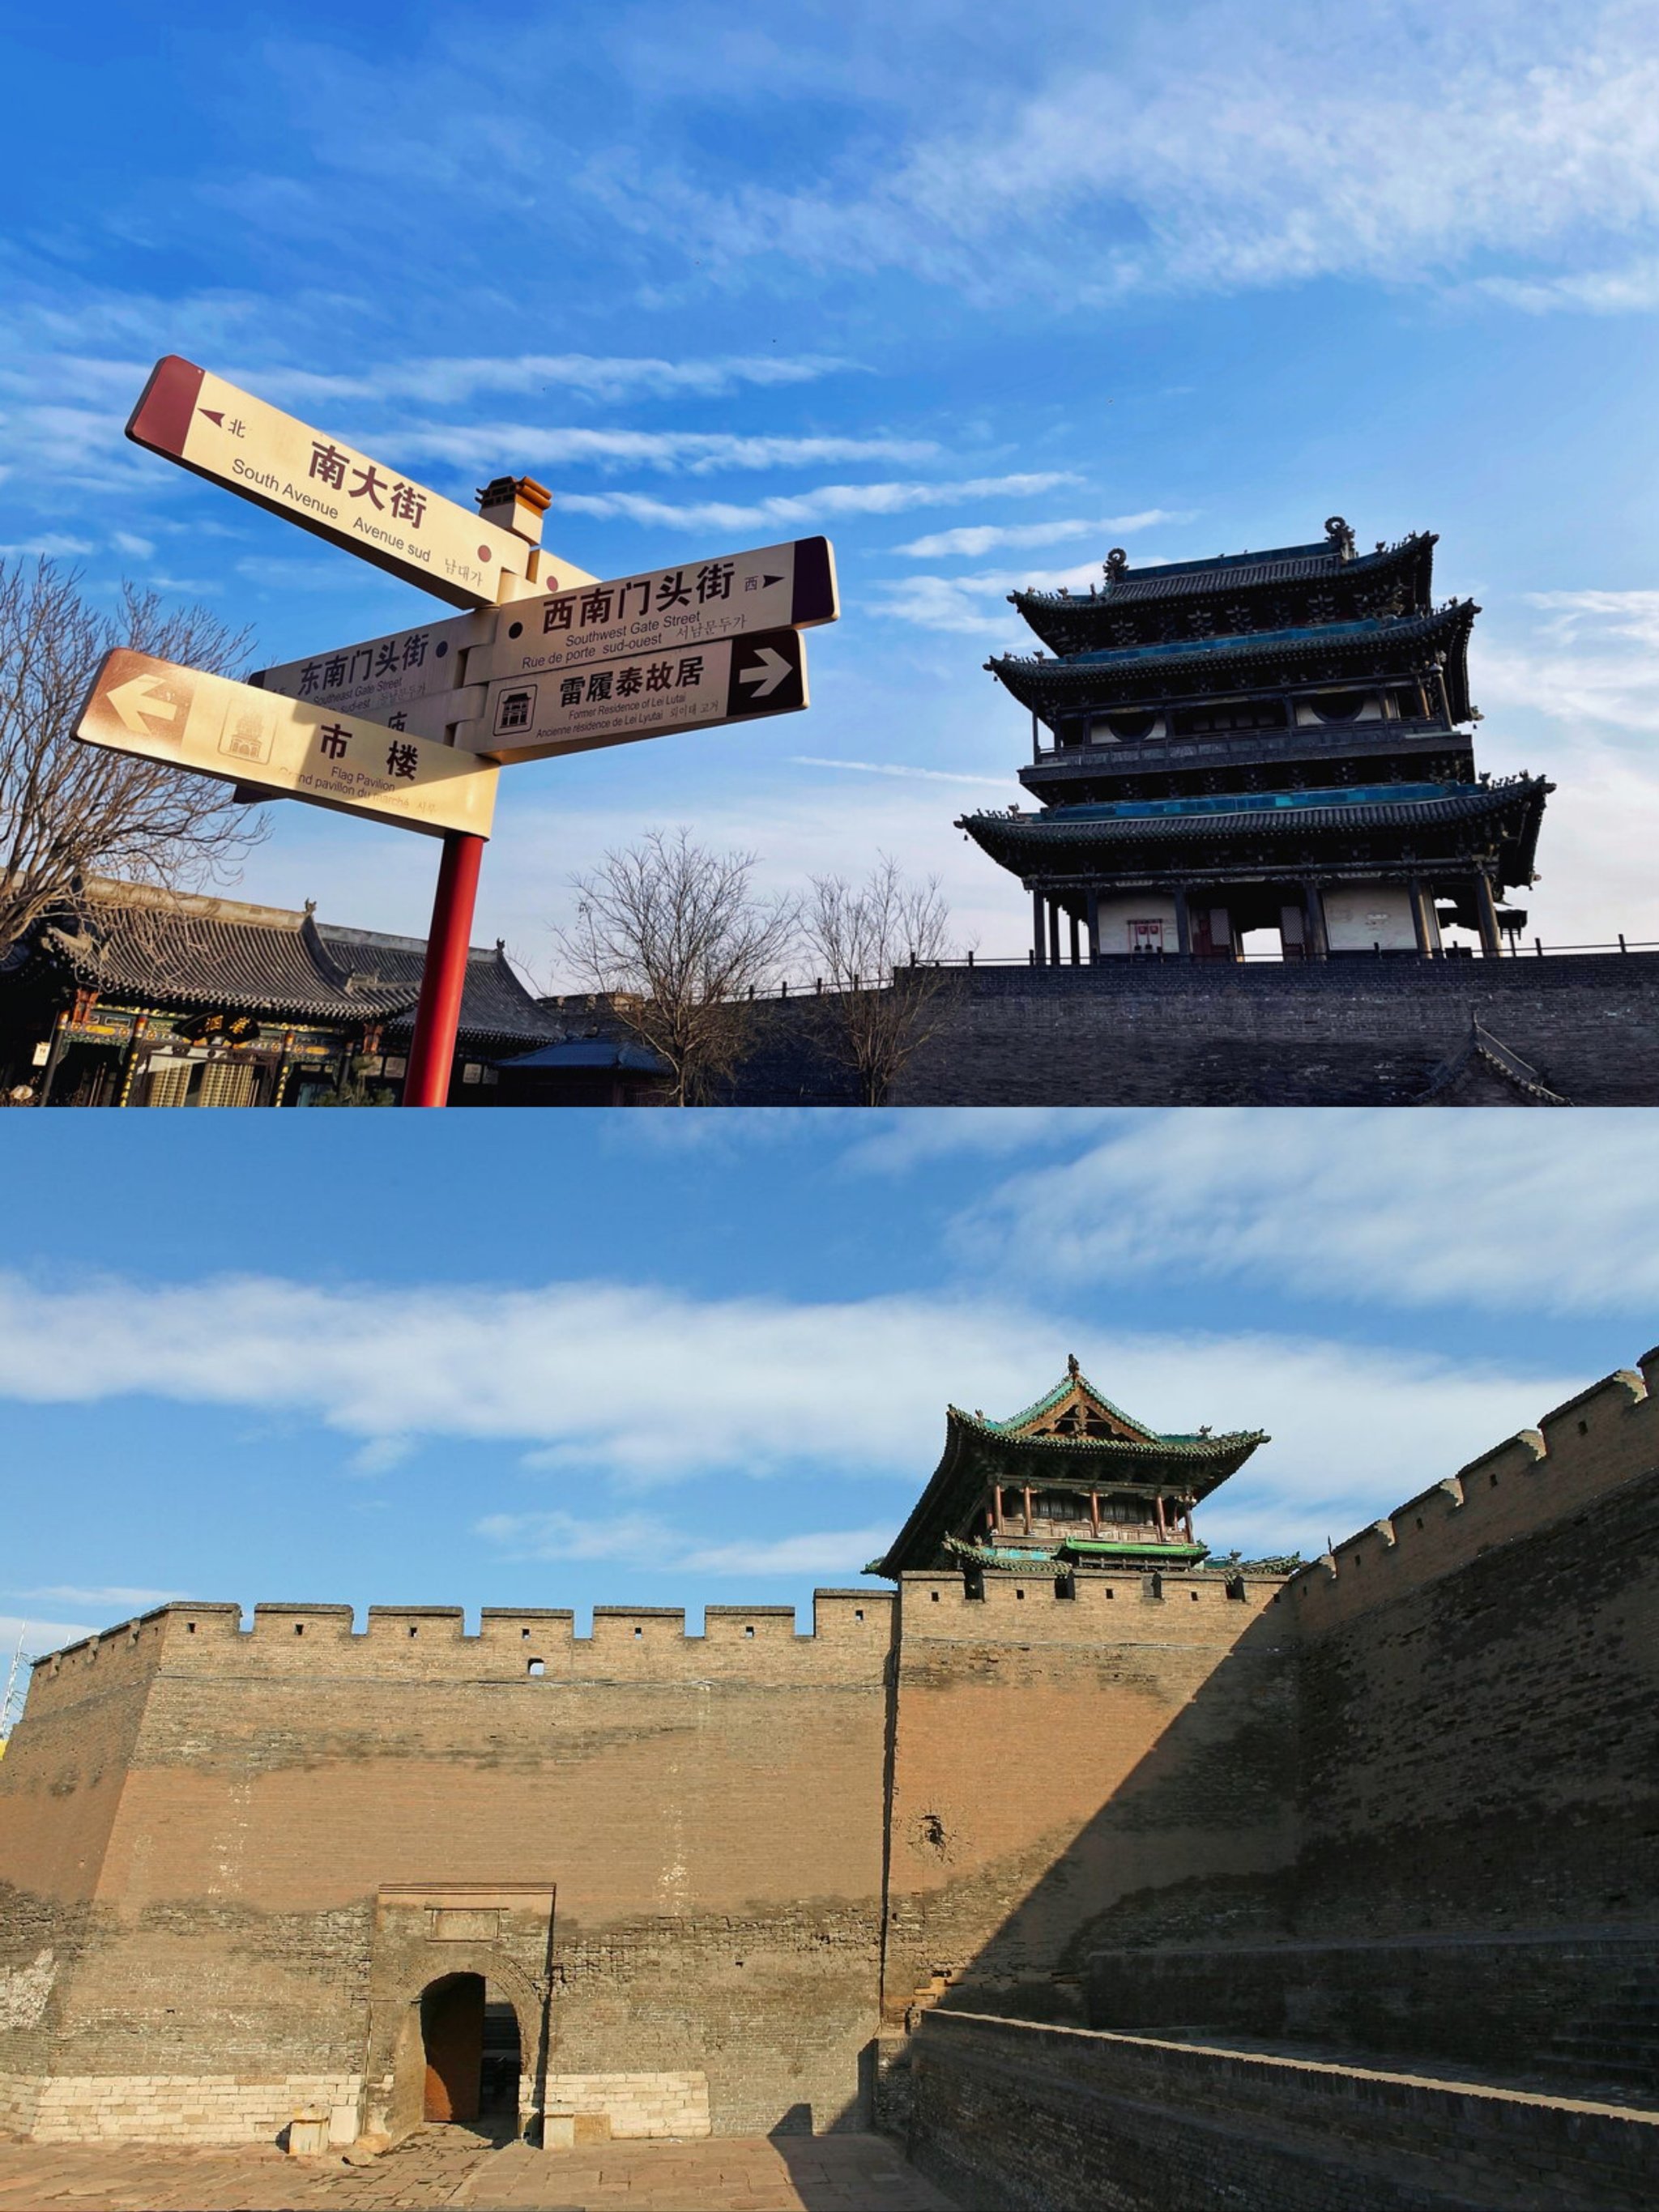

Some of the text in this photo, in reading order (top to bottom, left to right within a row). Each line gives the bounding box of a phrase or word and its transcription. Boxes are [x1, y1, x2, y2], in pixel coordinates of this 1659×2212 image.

[228, 419, 246, 438] 北
[309, 441, 427, 530] 南大街
[232, 458, 431, 562] South Avenue Avenue sud
[445, 557, 484, 587] 남대가
[744, 575, 759, 592] 西
[543, 562, 735, 634] 西南门头街
[565, 611, 701, 648] Southwest Gate Street
[298, 633, 429, 696] 东南门头街
[522, 632, 663, 669] Rue de porte sud-ouest
[313, 688, 354, 708] Southeast
[355, 683, 376, 697] Gate
[377, 677, 403, 693] Street
[560, 656, 704, 708] 雷履泰故居
[569, 706, 596, 721] Former
[598, 701, 640, 717] Residence
[641, 697, 650, 709] of
[651, 697, 664, 708] Lei
[612, 716, 622, 727] de
[625, 713, 638, 726] Lei
[331, 765, 395, 792] Flag Pavilion
